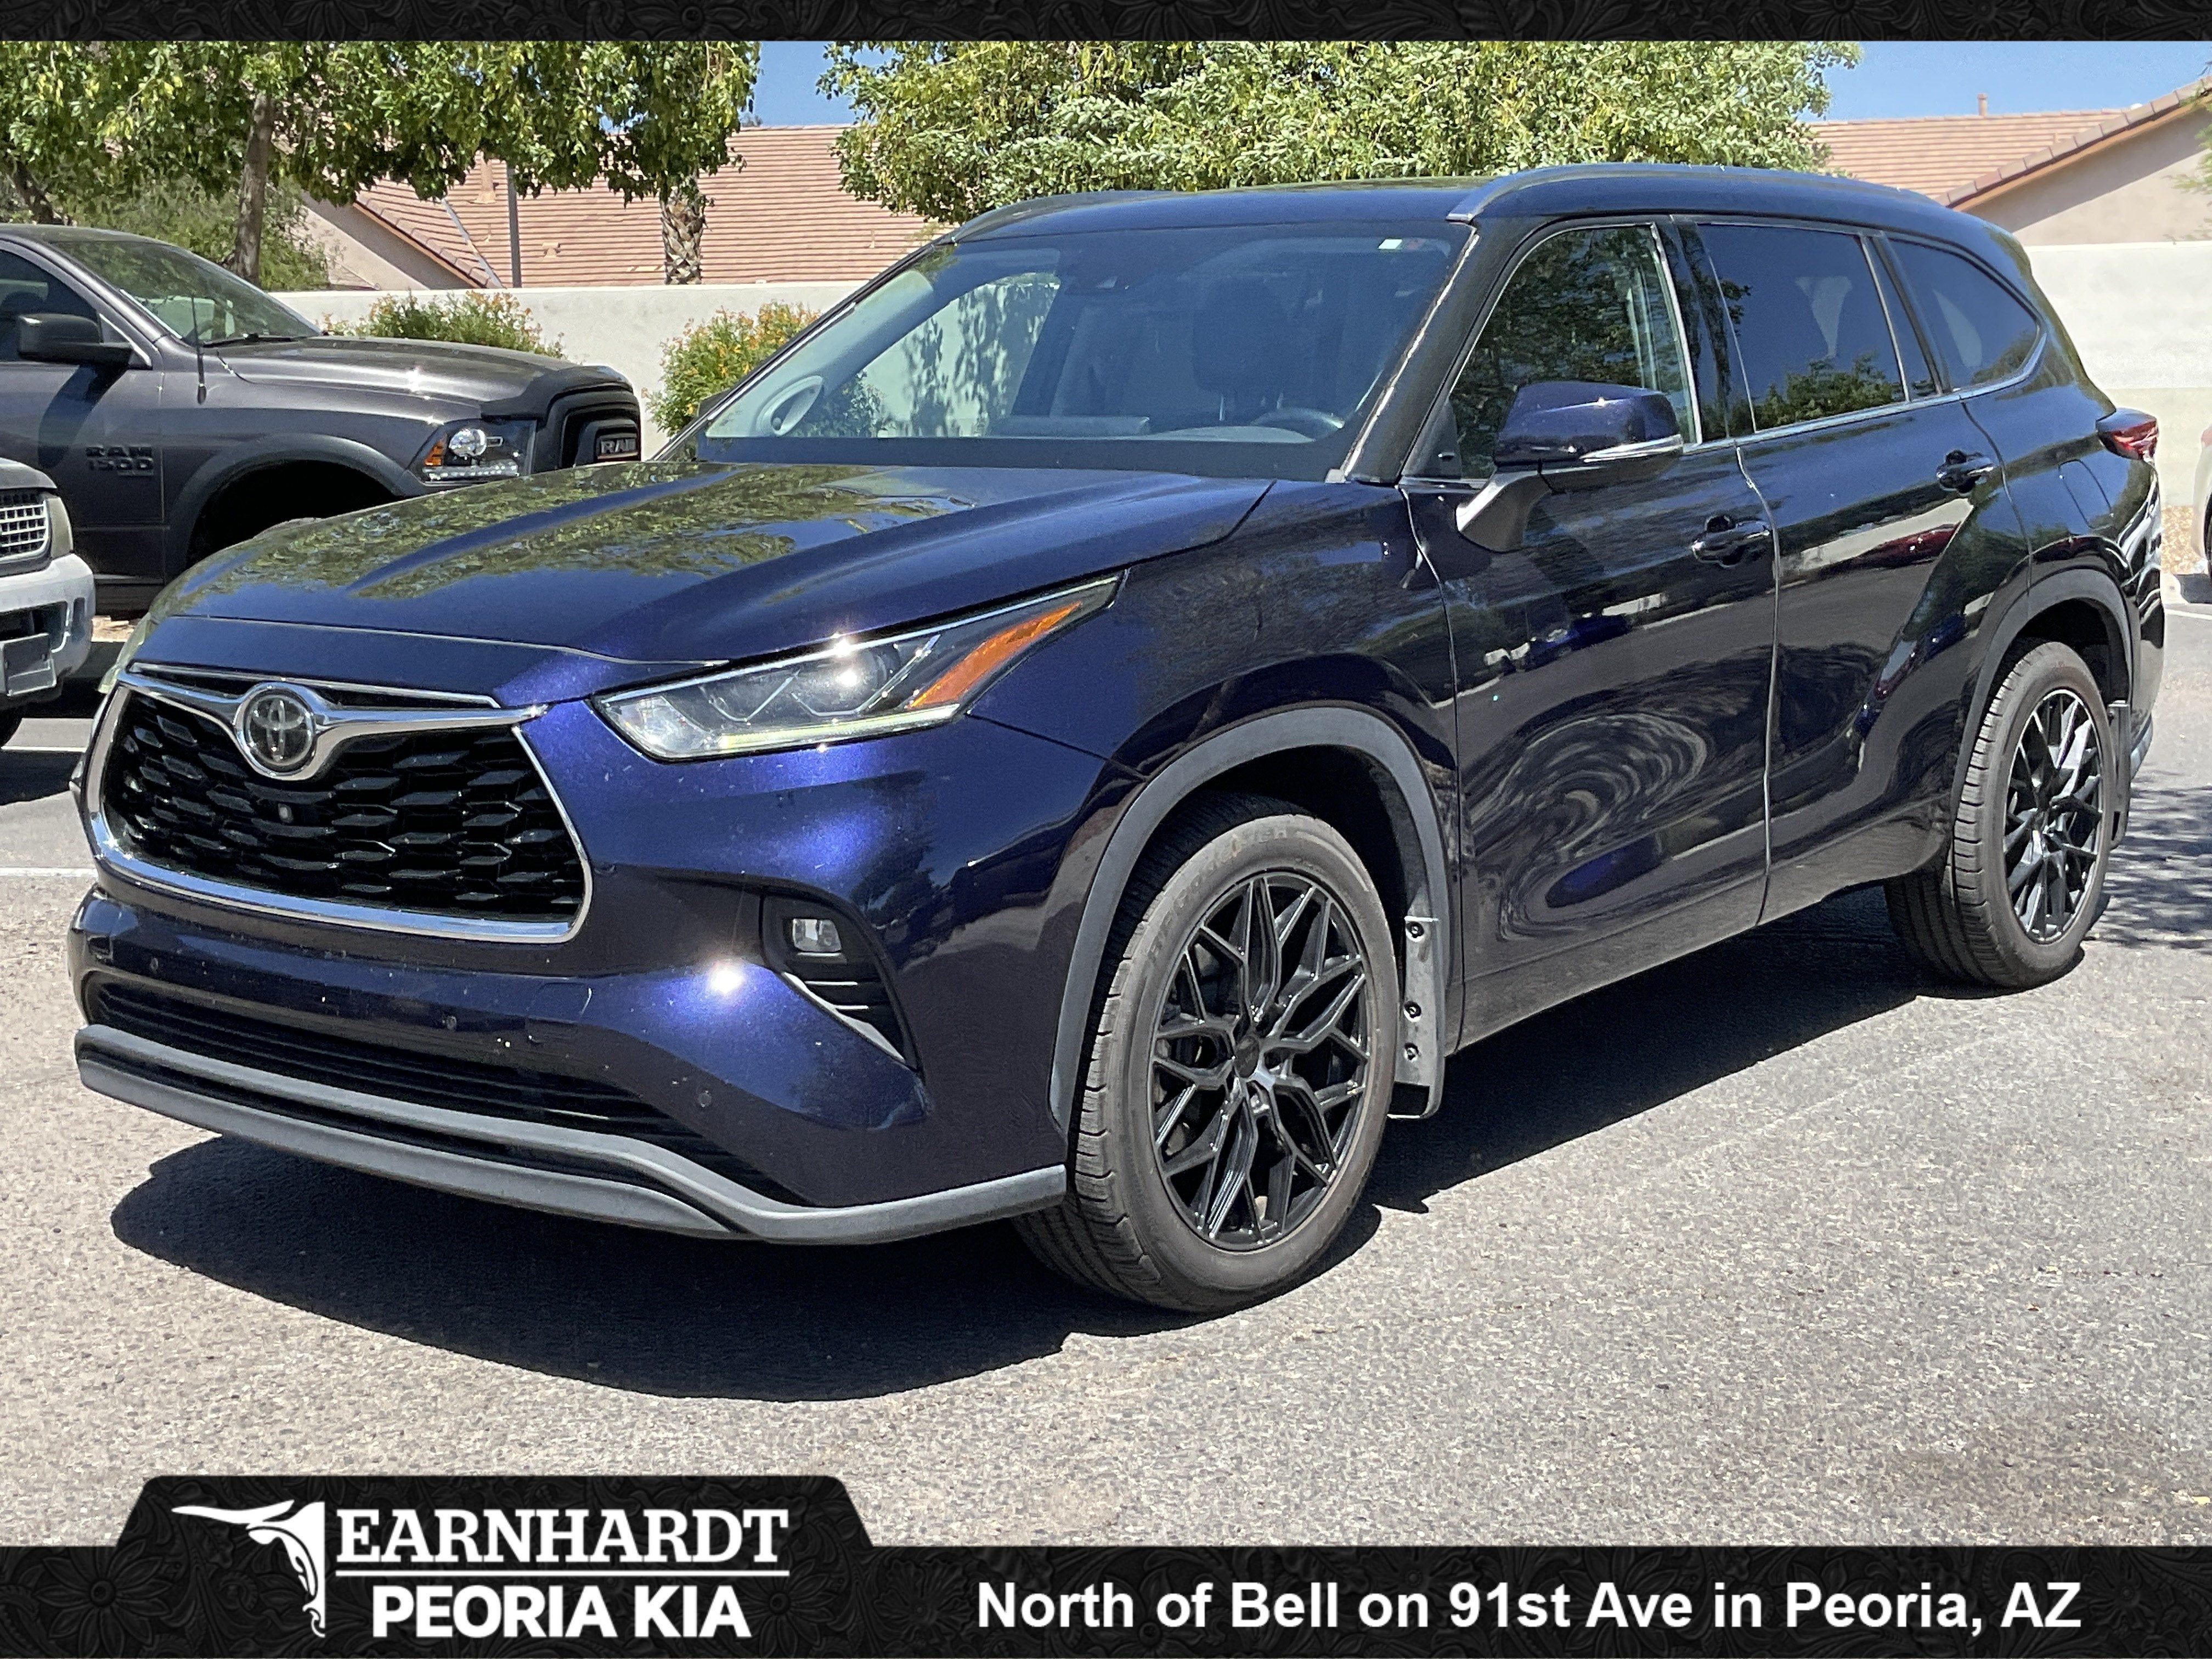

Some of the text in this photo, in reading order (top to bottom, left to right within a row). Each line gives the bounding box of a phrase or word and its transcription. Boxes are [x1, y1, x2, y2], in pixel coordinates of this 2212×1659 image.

[86, 445, 153, 457] RAM
[601, 438, 636, 454] RAM
[89, 458, 154, 471] 1500
